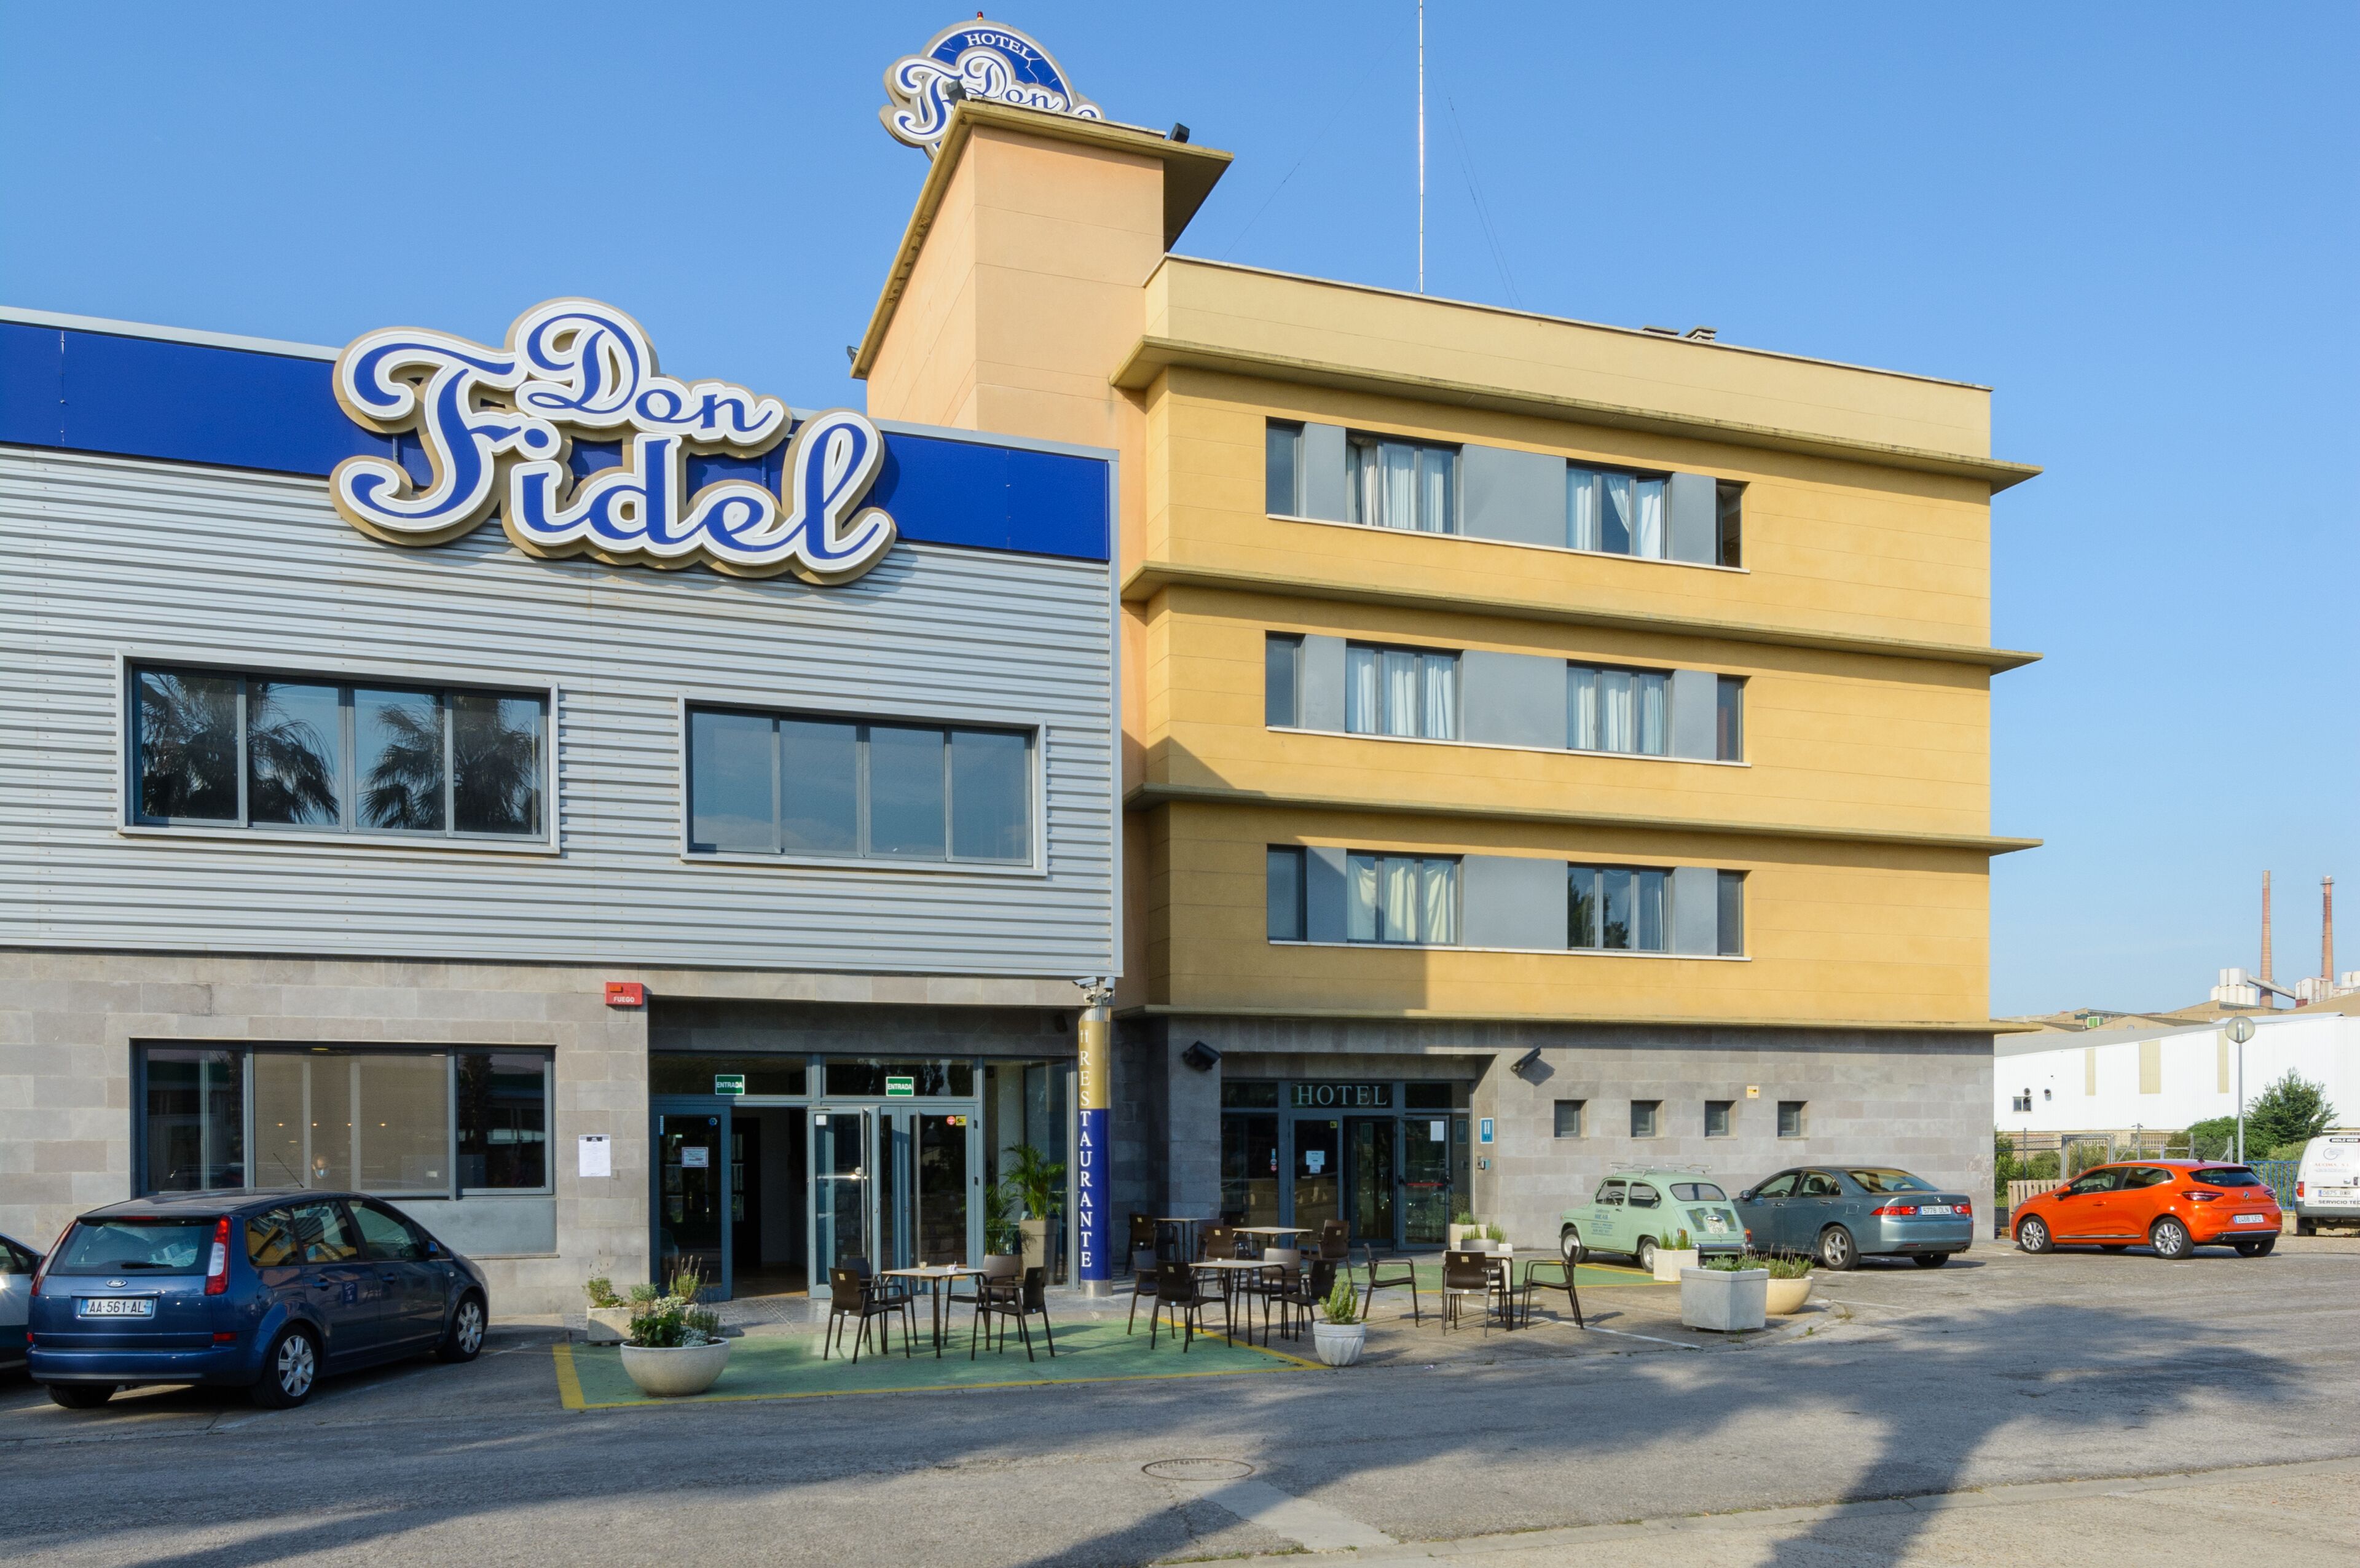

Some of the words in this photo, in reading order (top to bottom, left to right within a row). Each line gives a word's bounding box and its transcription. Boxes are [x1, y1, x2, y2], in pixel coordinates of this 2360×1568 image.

[965, 33, 1032, 61] HOTEL
[964, 56, 1060, 109] Don
[526, 313, 773, 431] Don
[350, 342, 881, 561] Fidel
[1297, 1085, 1387, 1105] HOTEL
[1080, 1051, 1093, 1268] RESTAURANTE
[89, 1301, 144, 1313] AA-561-AL
